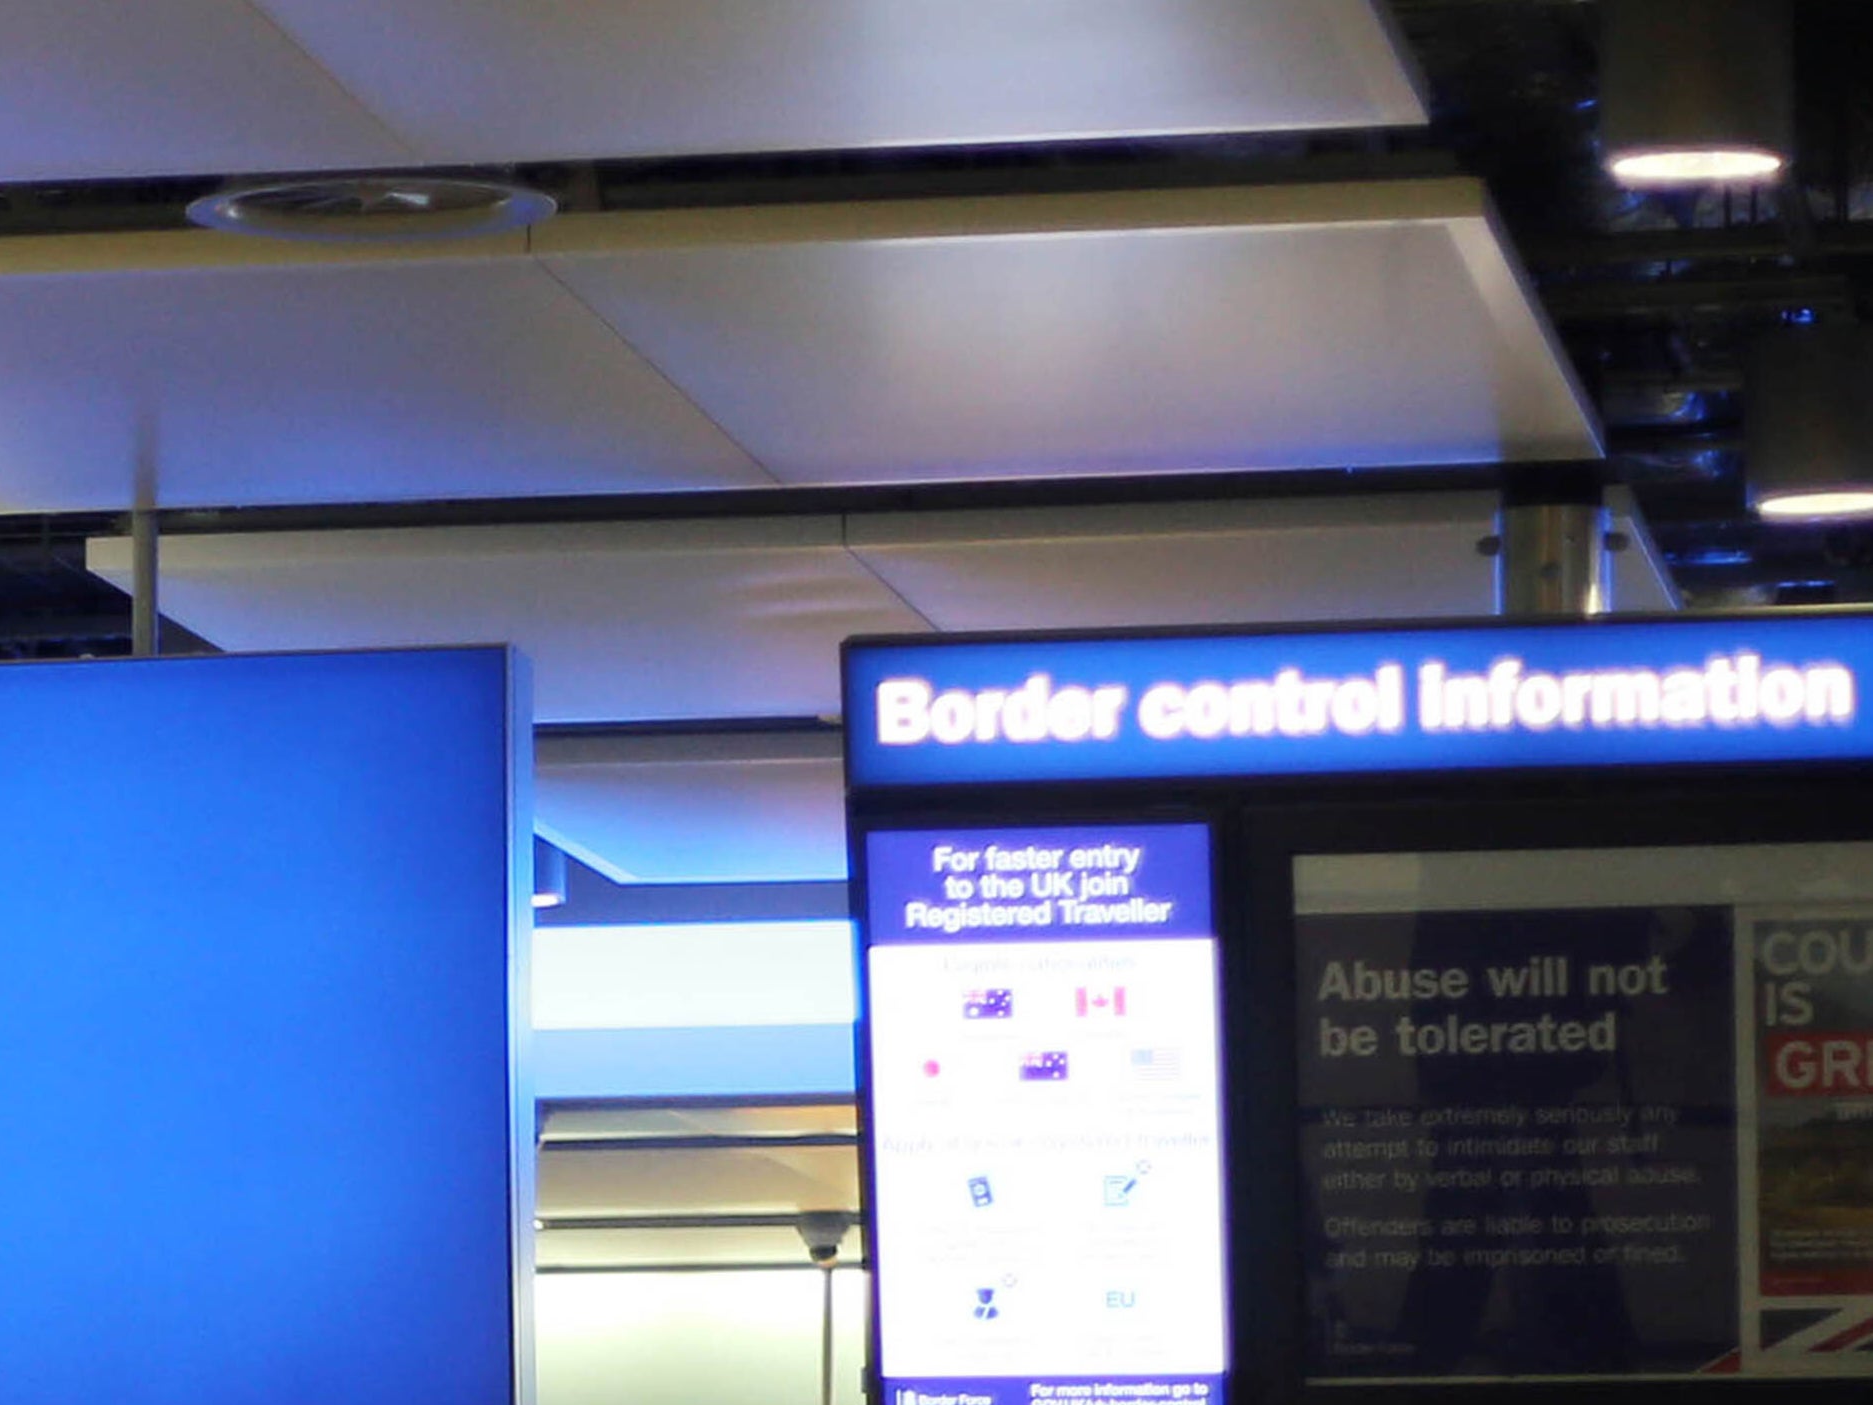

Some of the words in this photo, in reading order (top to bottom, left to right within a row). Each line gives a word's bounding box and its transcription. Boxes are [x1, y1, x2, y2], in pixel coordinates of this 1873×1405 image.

[876, 672, 1128, 744] Border
[1137, 662, 1405, 739] control
[1417, 651, 1855, 731] information
[932, 846, 980, 873] For
[985, 845, 1064, 872] faster
[1068, 844, 1141, 874] entry
[944, 874, 975, 900] to
[979, 873, 1025, 899] the
[1030, 872, 1074, 899] UK
[1080, 870, 1129, 901] join
[905, 900, 1052, 933] Registered
[1058, 897, 1172, 924] Traveller
[1318, 960, 1469, 1003] Abuse
[1486, 956, 1568, 998] will
[1587, 954, 1669, 996] not
[1765, 980, 1815, 1028] IS
[1319, 1016, 1379, 1058] be
[1395, 1011, 1617, 1056] tolerated
[1106, 1290, 1136, 1309] EU
[1029, 1383, 1054, 1398] For
[1093, 1382, 1169, 1397] information
[1172, 1384, 1191, 1399] go
[1192, 1382, 1210, 1396] to
